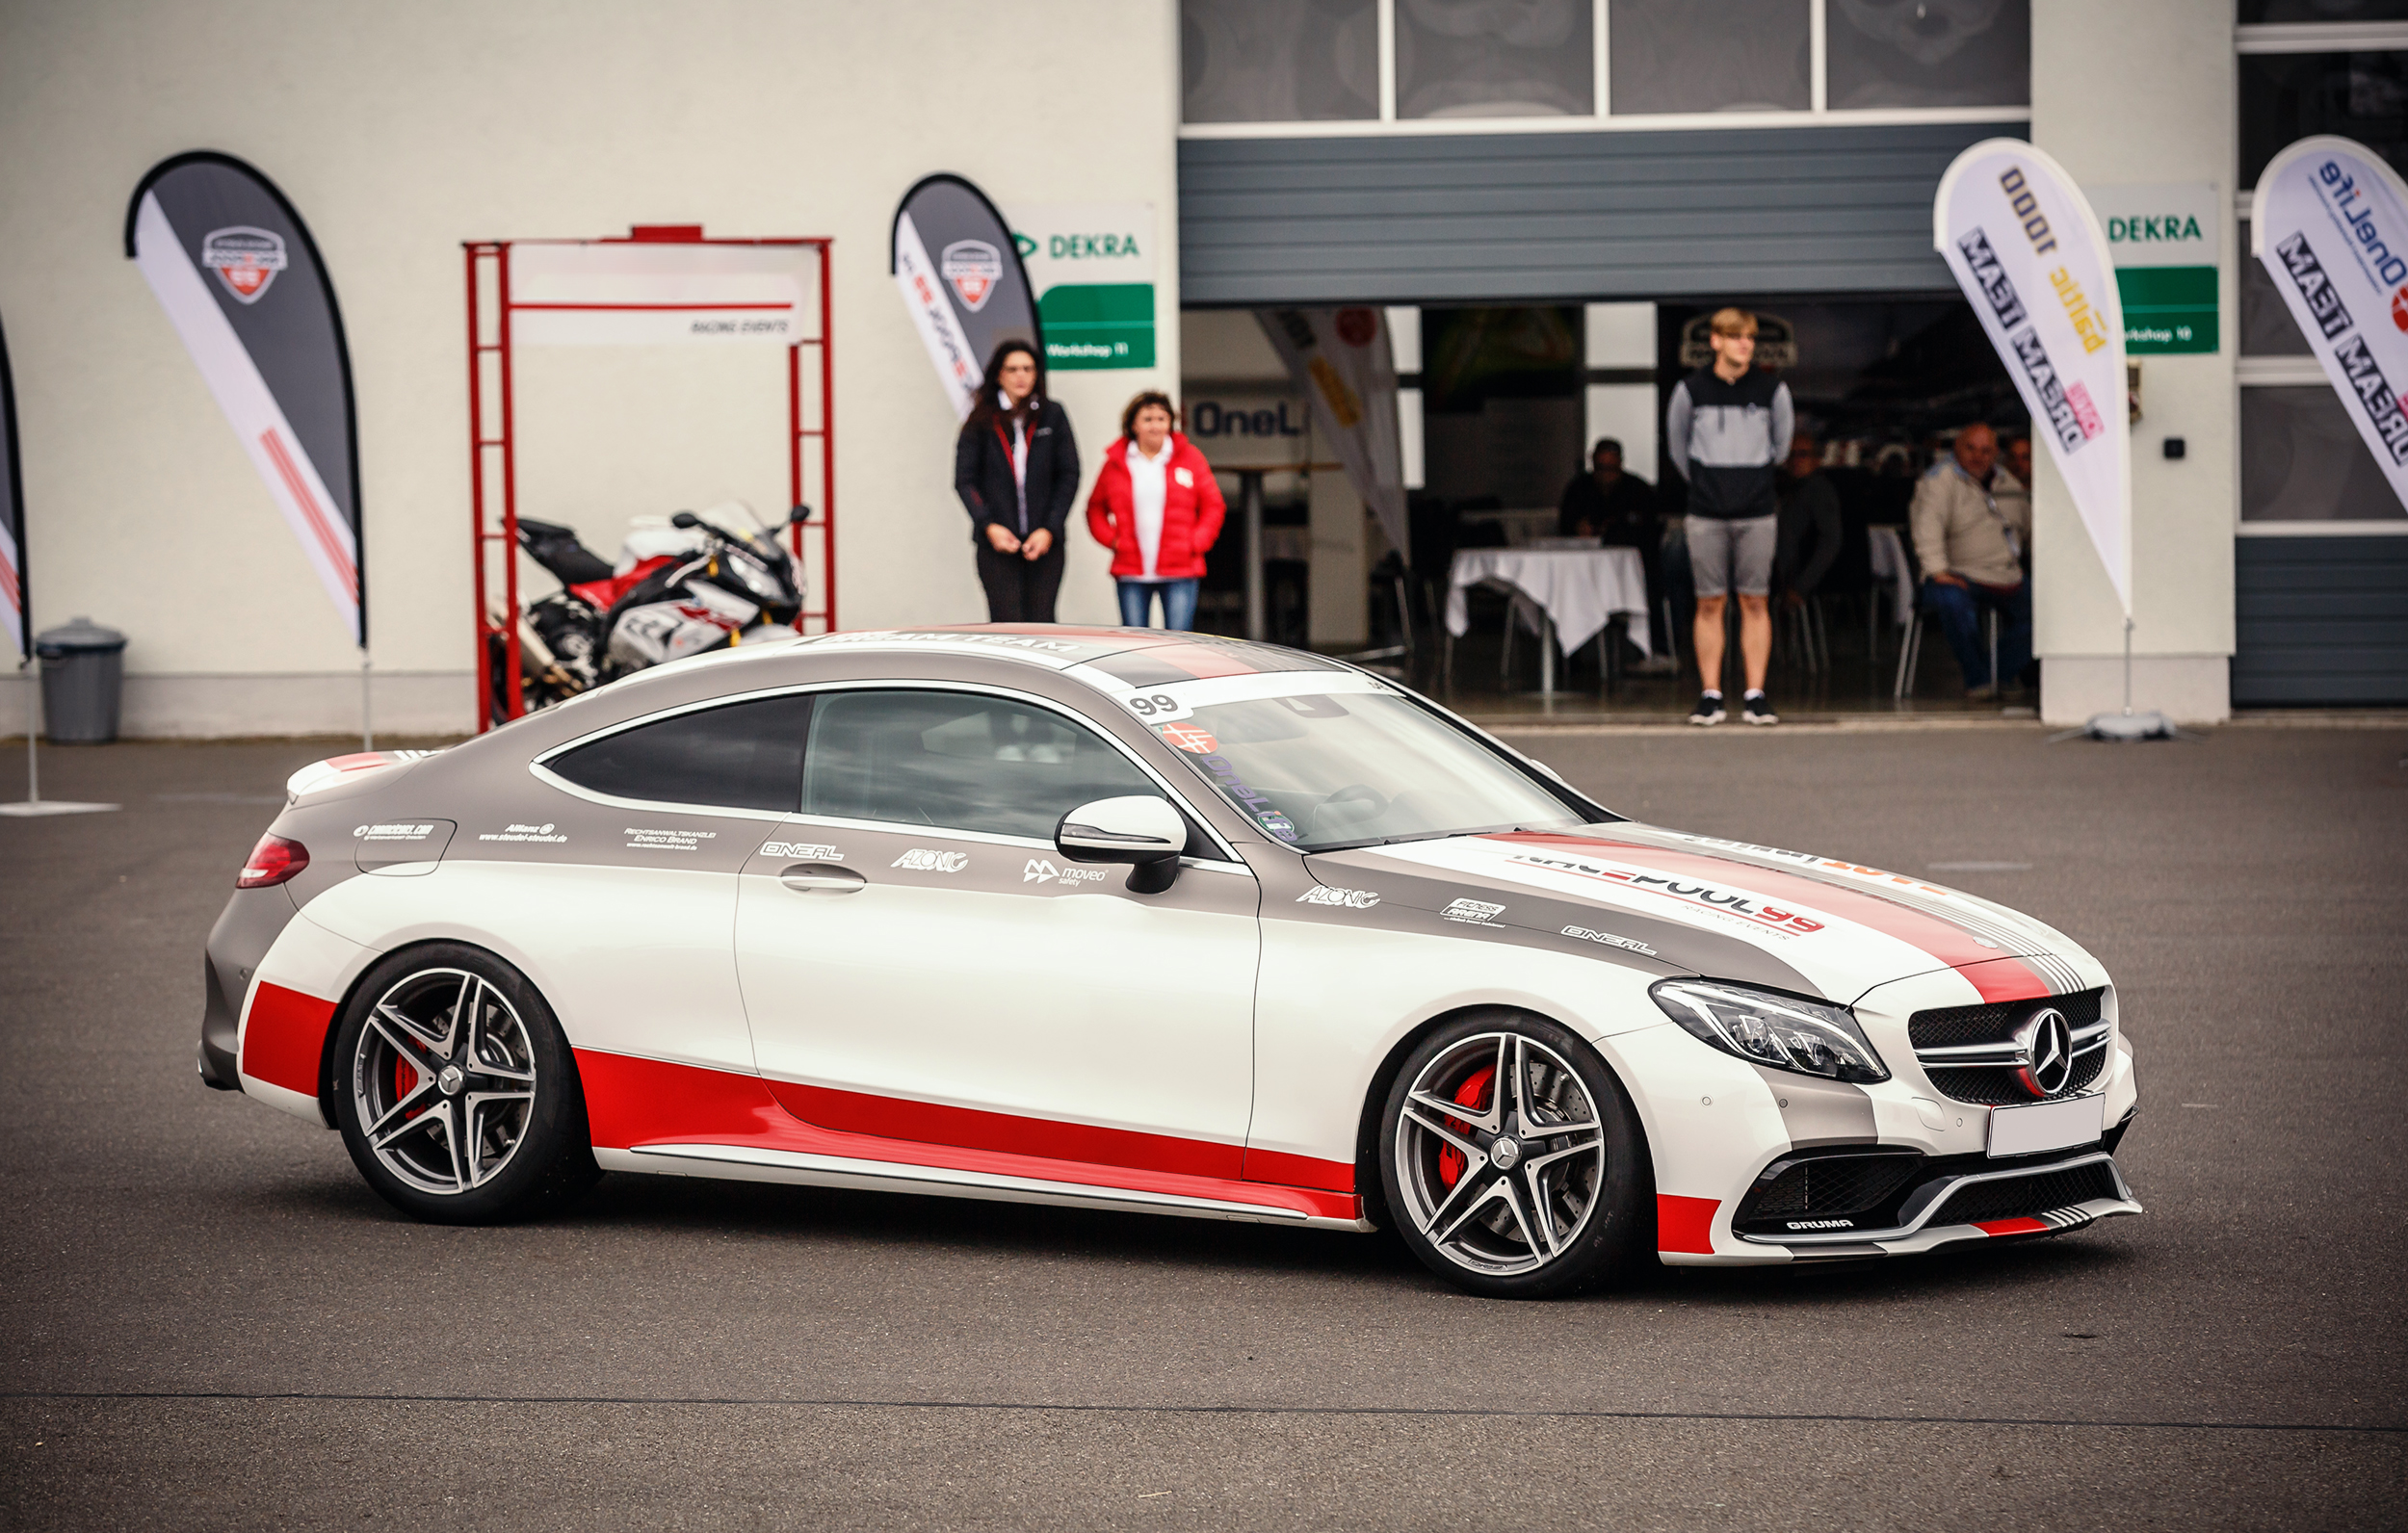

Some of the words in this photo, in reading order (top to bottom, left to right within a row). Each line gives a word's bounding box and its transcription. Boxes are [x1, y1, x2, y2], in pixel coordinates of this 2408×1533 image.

[2108, 215, 2203, 242] DEKRA
[1049, 233, 1139, 259] DEKRA
[1046, 342, 1112, 359] Workshop
[964, 634, 1080, 653] TEAM
[1130, 694, 1178, 715] 99
[1202, 755, 1297, 843] OneLife
[505, 824, 540, 833] Allianz
[667, 836, 697, 844] BRAND
[890, 848, 969, 873] AZONIC
[1059, 876, 1082, 887] safety
[1061, 868, 1106, 881] moveo
[1296, 885, 1381, 909] AZONIC
[1684, 904, 1734, 925] RACING
[1735, 920, 1791, 941] EVENTS
[1786, 1219, 1854, 1230] GRUMA
